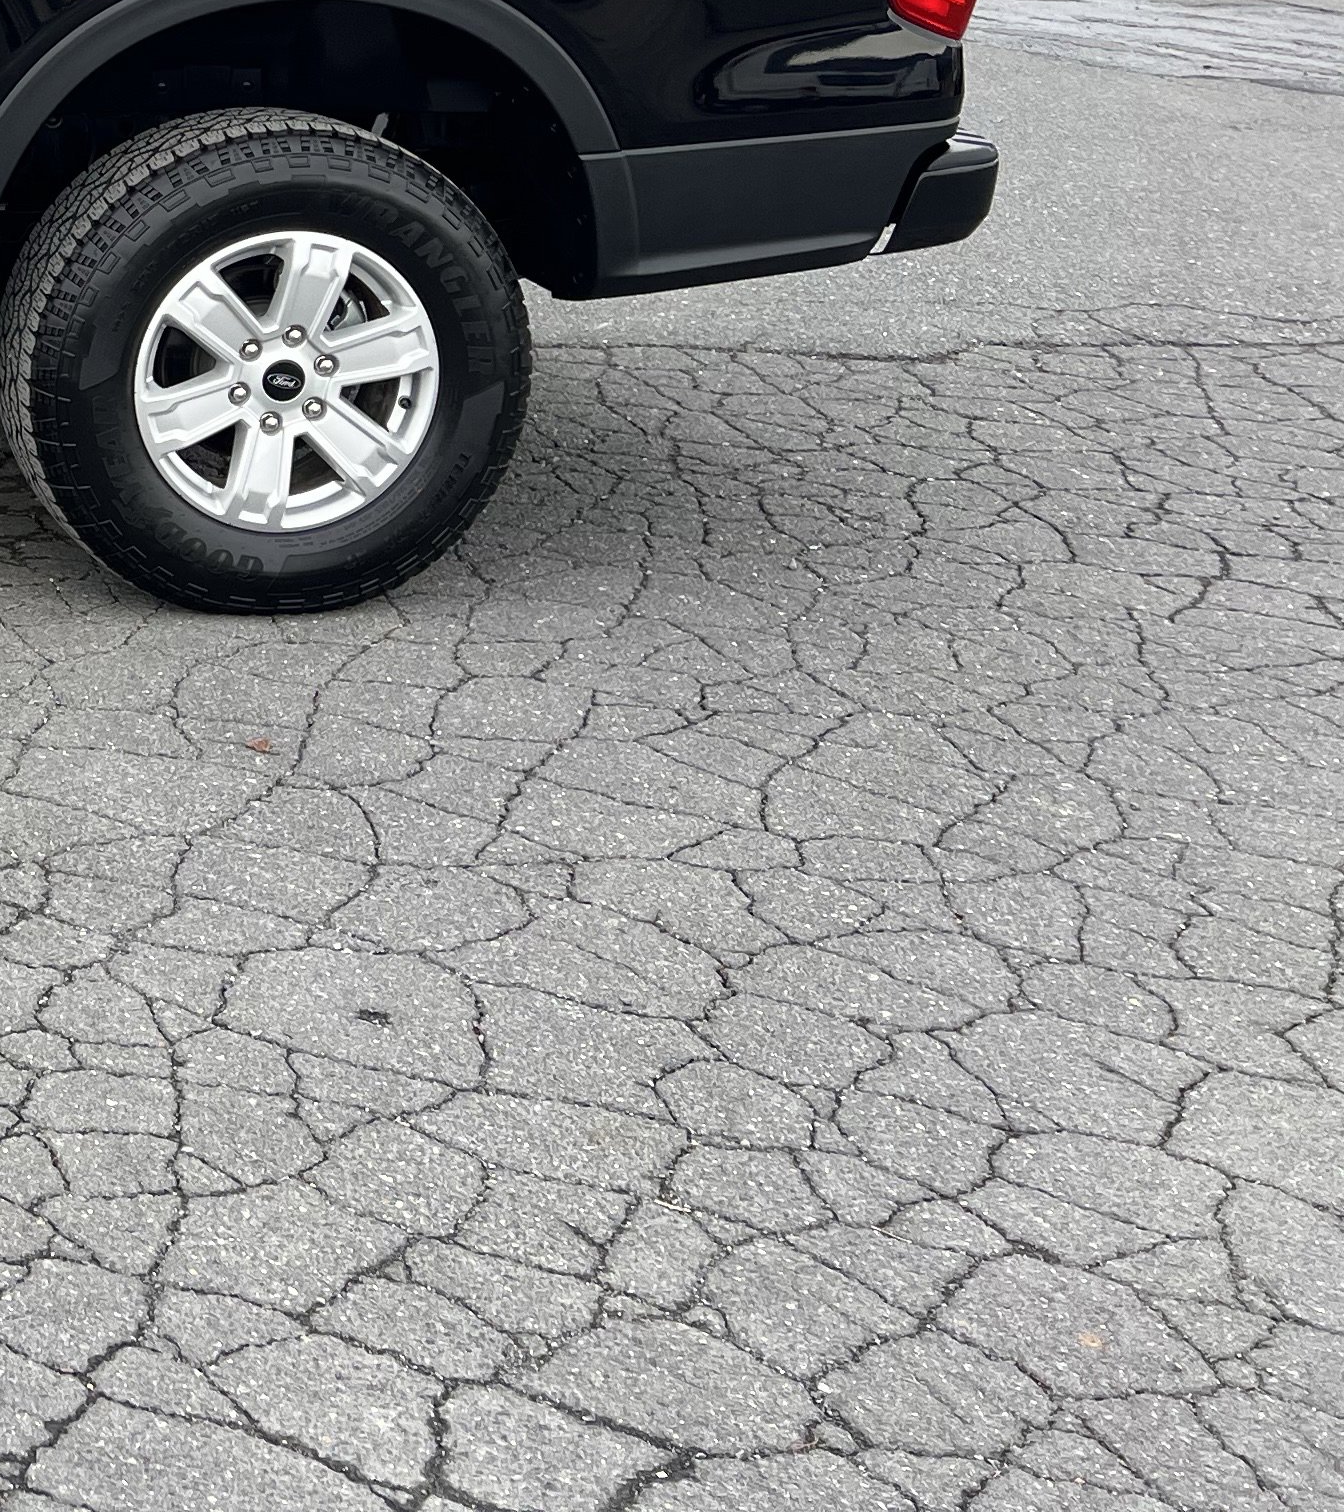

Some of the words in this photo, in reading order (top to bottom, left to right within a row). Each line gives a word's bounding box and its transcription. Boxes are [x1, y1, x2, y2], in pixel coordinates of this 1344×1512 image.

[338, 192, 496, 374] WRANGLER
[271, 374, 297, 388] Ford
[91, 394, 264, 578] GOODYEAR
